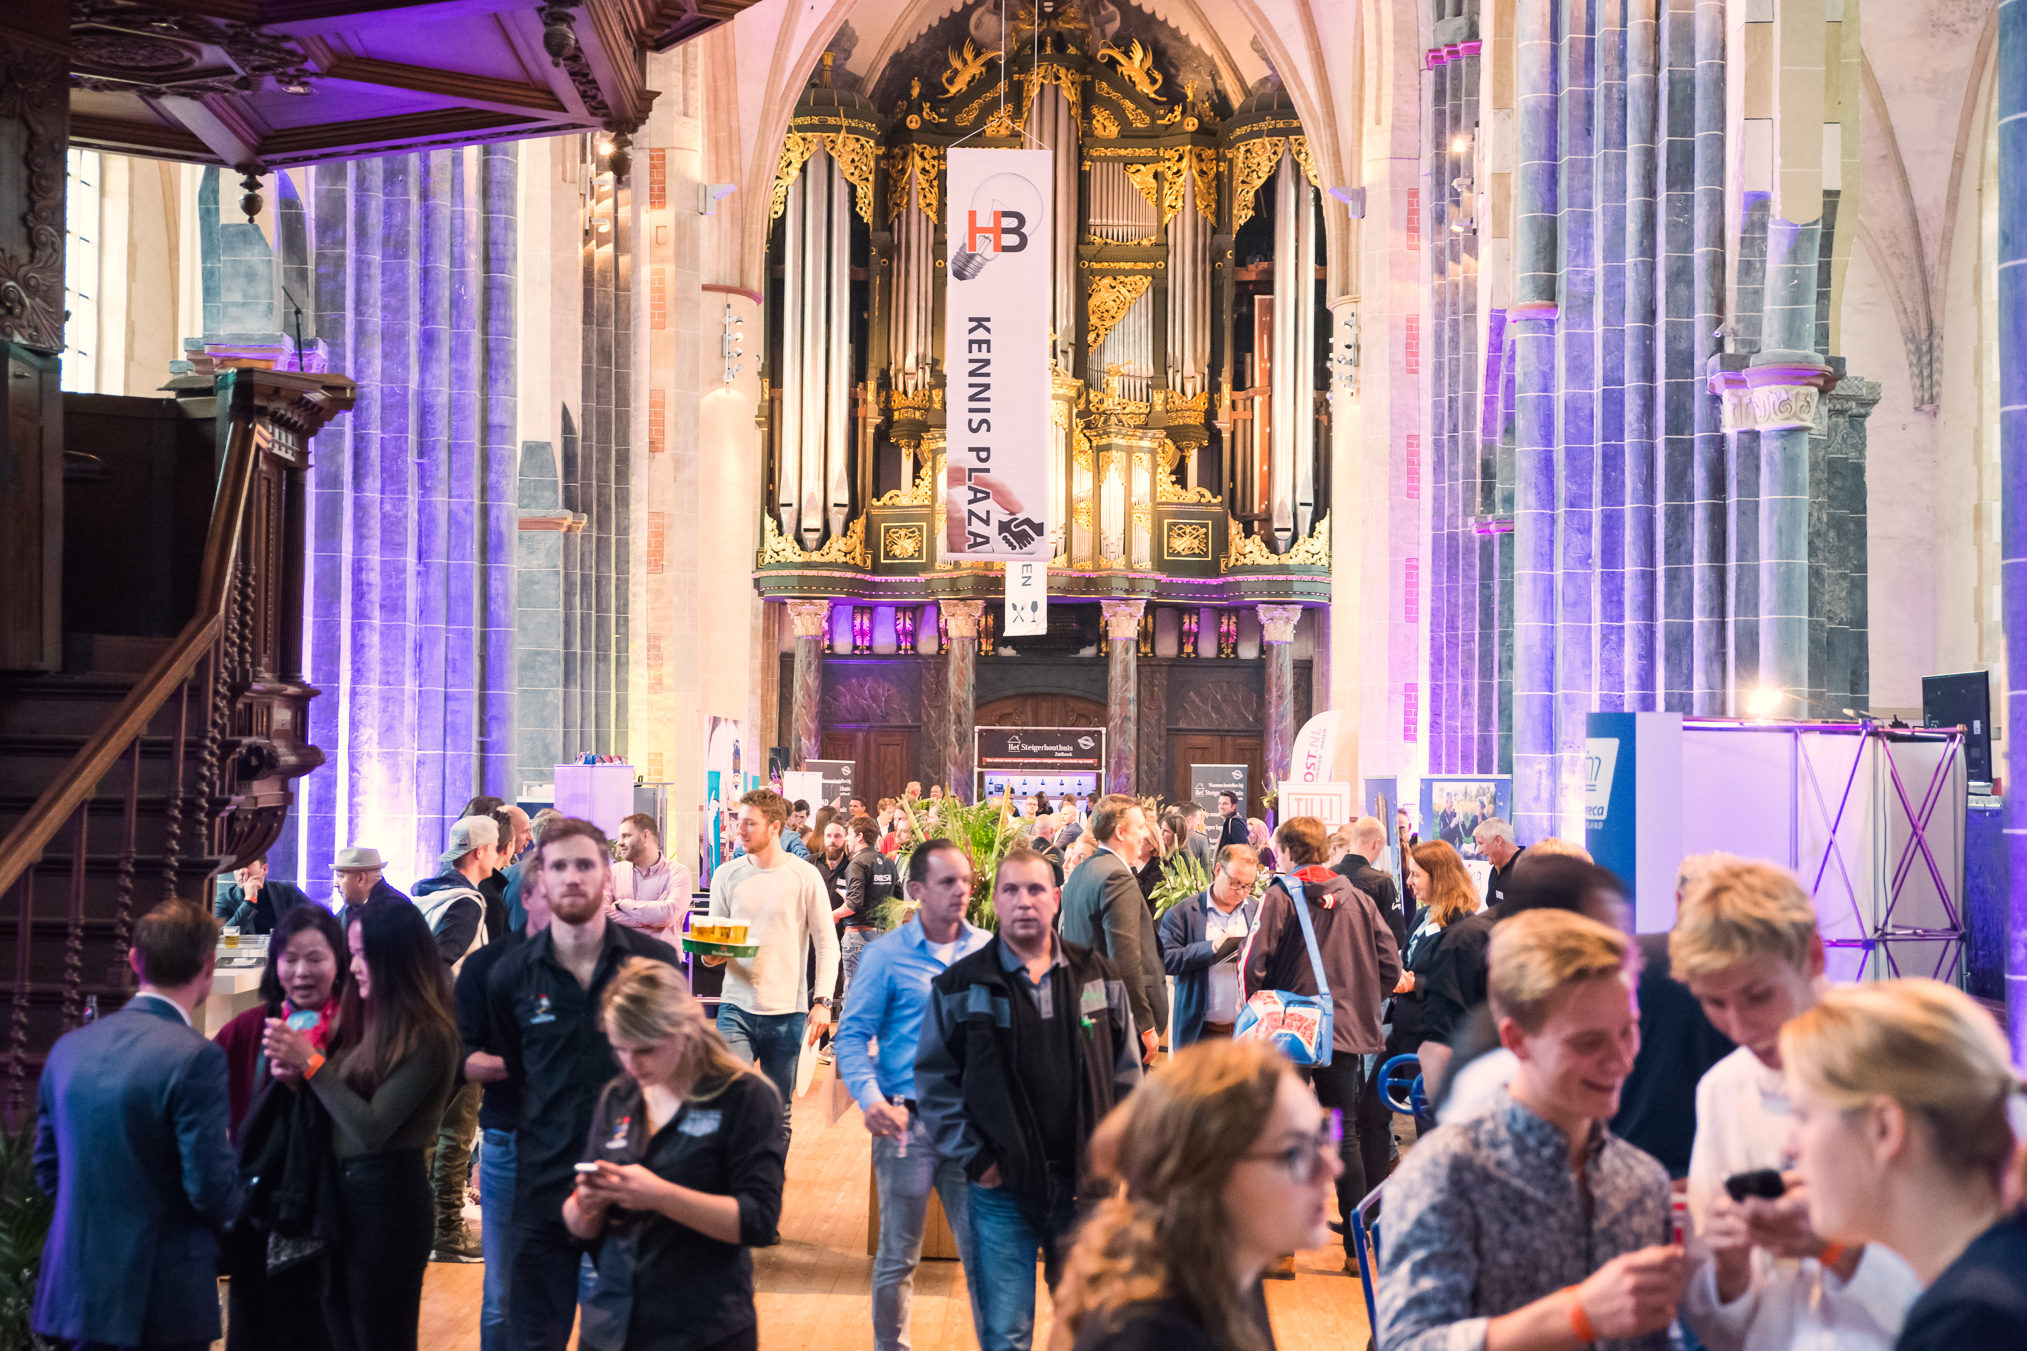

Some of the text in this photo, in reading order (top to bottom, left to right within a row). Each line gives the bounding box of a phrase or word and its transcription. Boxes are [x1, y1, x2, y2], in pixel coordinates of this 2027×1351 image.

[968, 210, 1028, 253] HB
[967, 317, 991, 550] KENNIS PLAZA
